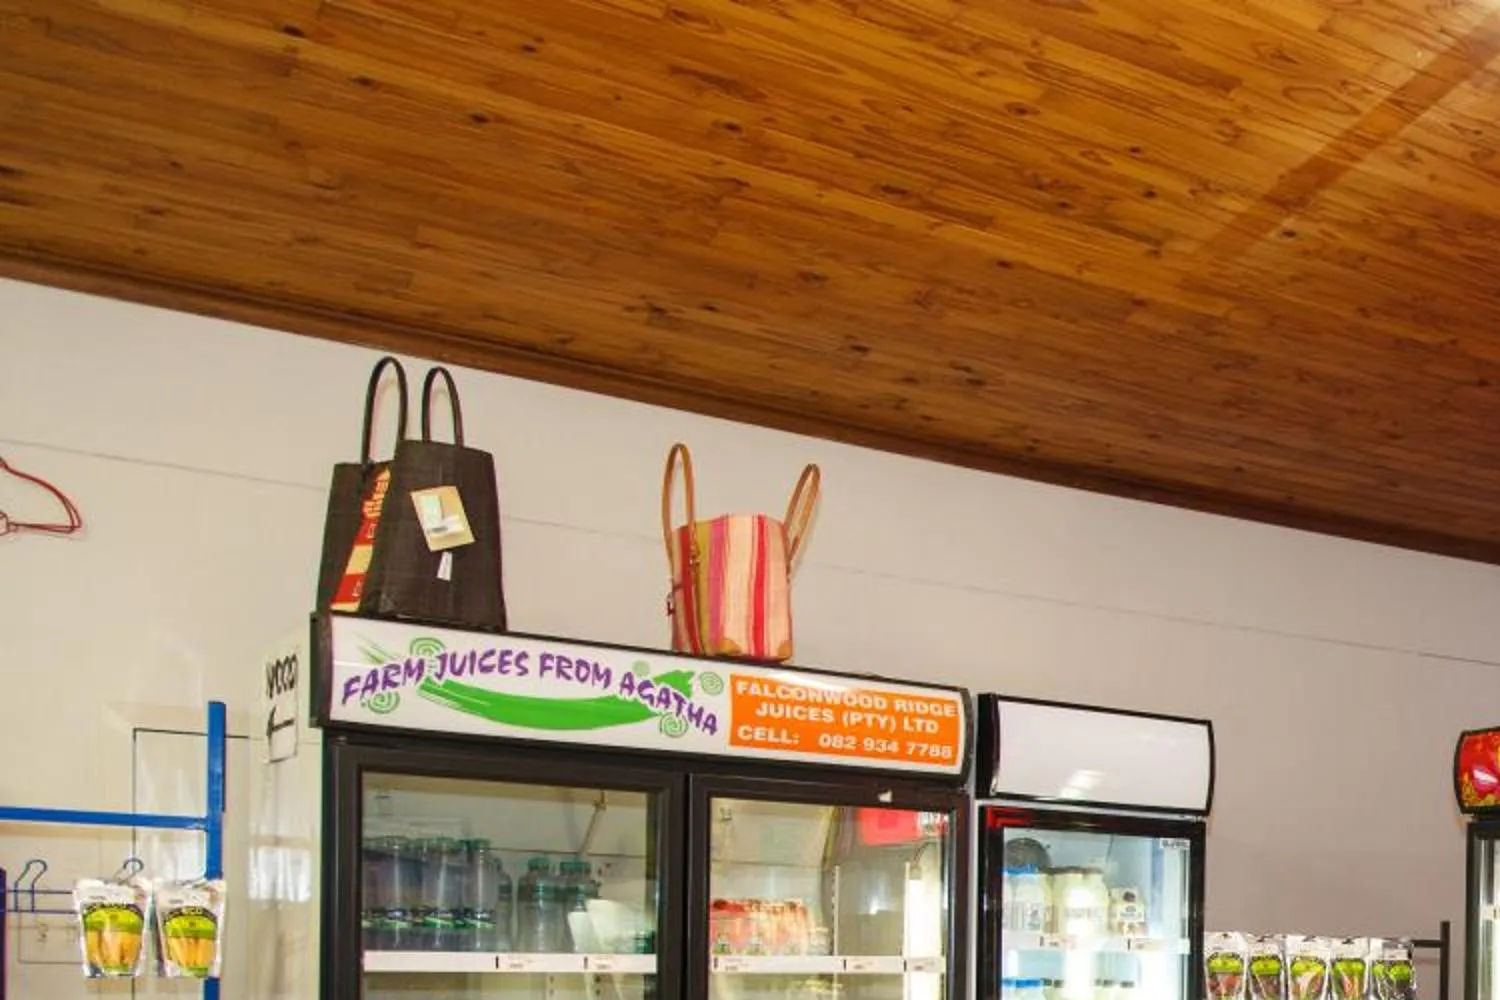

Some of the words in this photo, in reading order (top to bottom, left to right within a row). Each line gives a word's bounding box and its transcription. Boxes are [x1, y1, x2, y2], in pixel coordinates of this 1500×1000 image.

[341, 657, 426, 707] FARM
[433, 648, 531, 682] JUICES
[538, 651, 613, 691] FROM
[618, 670, 719, 737] AGATHA
[735, 680, 889, 711] FALCONWOOD
[893, 698, 958, 718] RIDGE
[755, 701, 835, 724] JUICES
[842, 710, 898, 734] (PTY)
[903, 717, 940, 735] LTD
[737, 724, 800, 745] CELL:
[818, 732, 857, 751] 082
